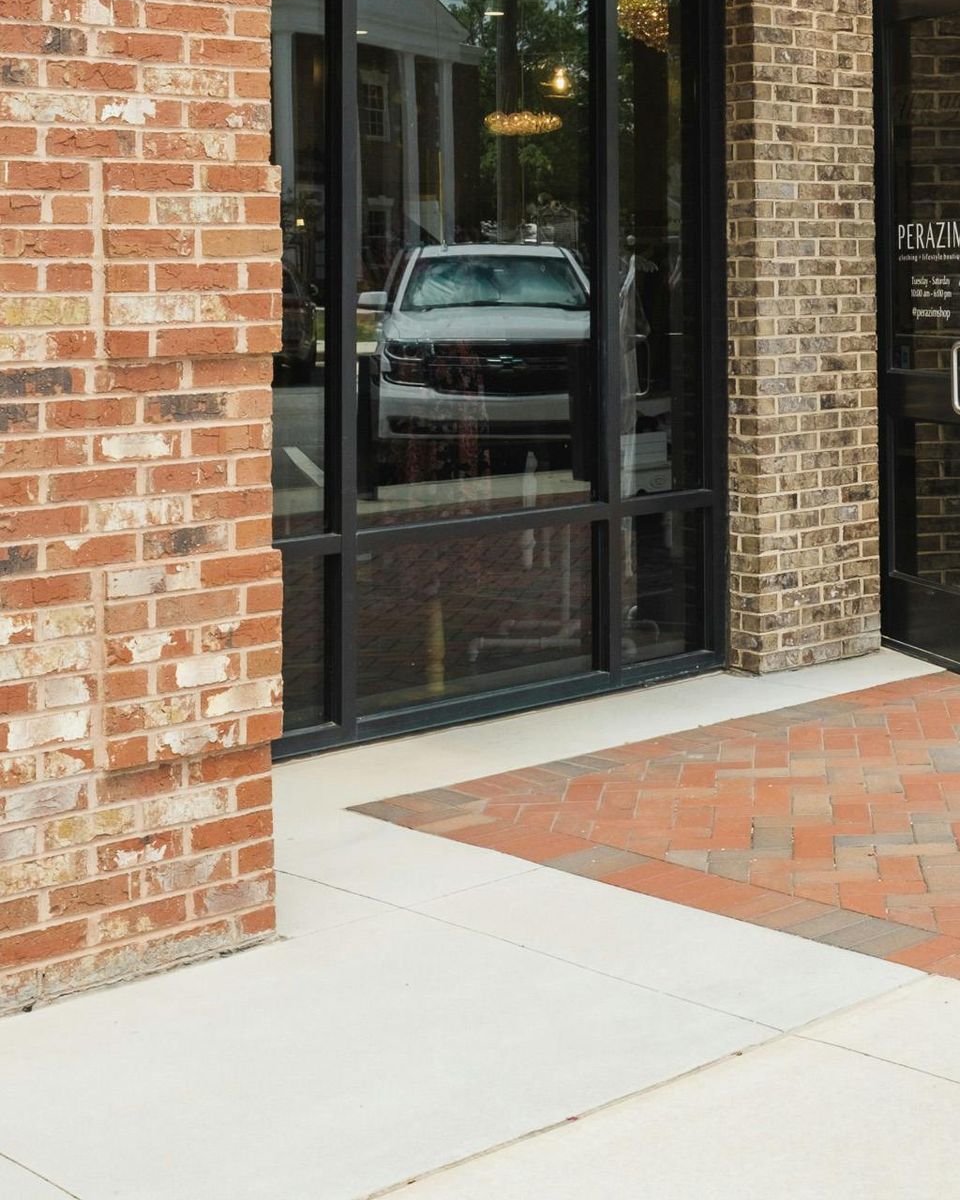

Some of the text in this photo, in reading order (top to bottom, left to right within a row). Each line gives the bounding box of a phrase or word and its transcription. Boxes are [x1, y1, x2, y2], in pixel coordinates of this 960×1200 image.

[911, 276, 929, 287] Tuesday
[932, 275, 950, 286] Saturday
[944, 291, 952, 300] pm
[912, 306, 951, 320] @perazimshop
